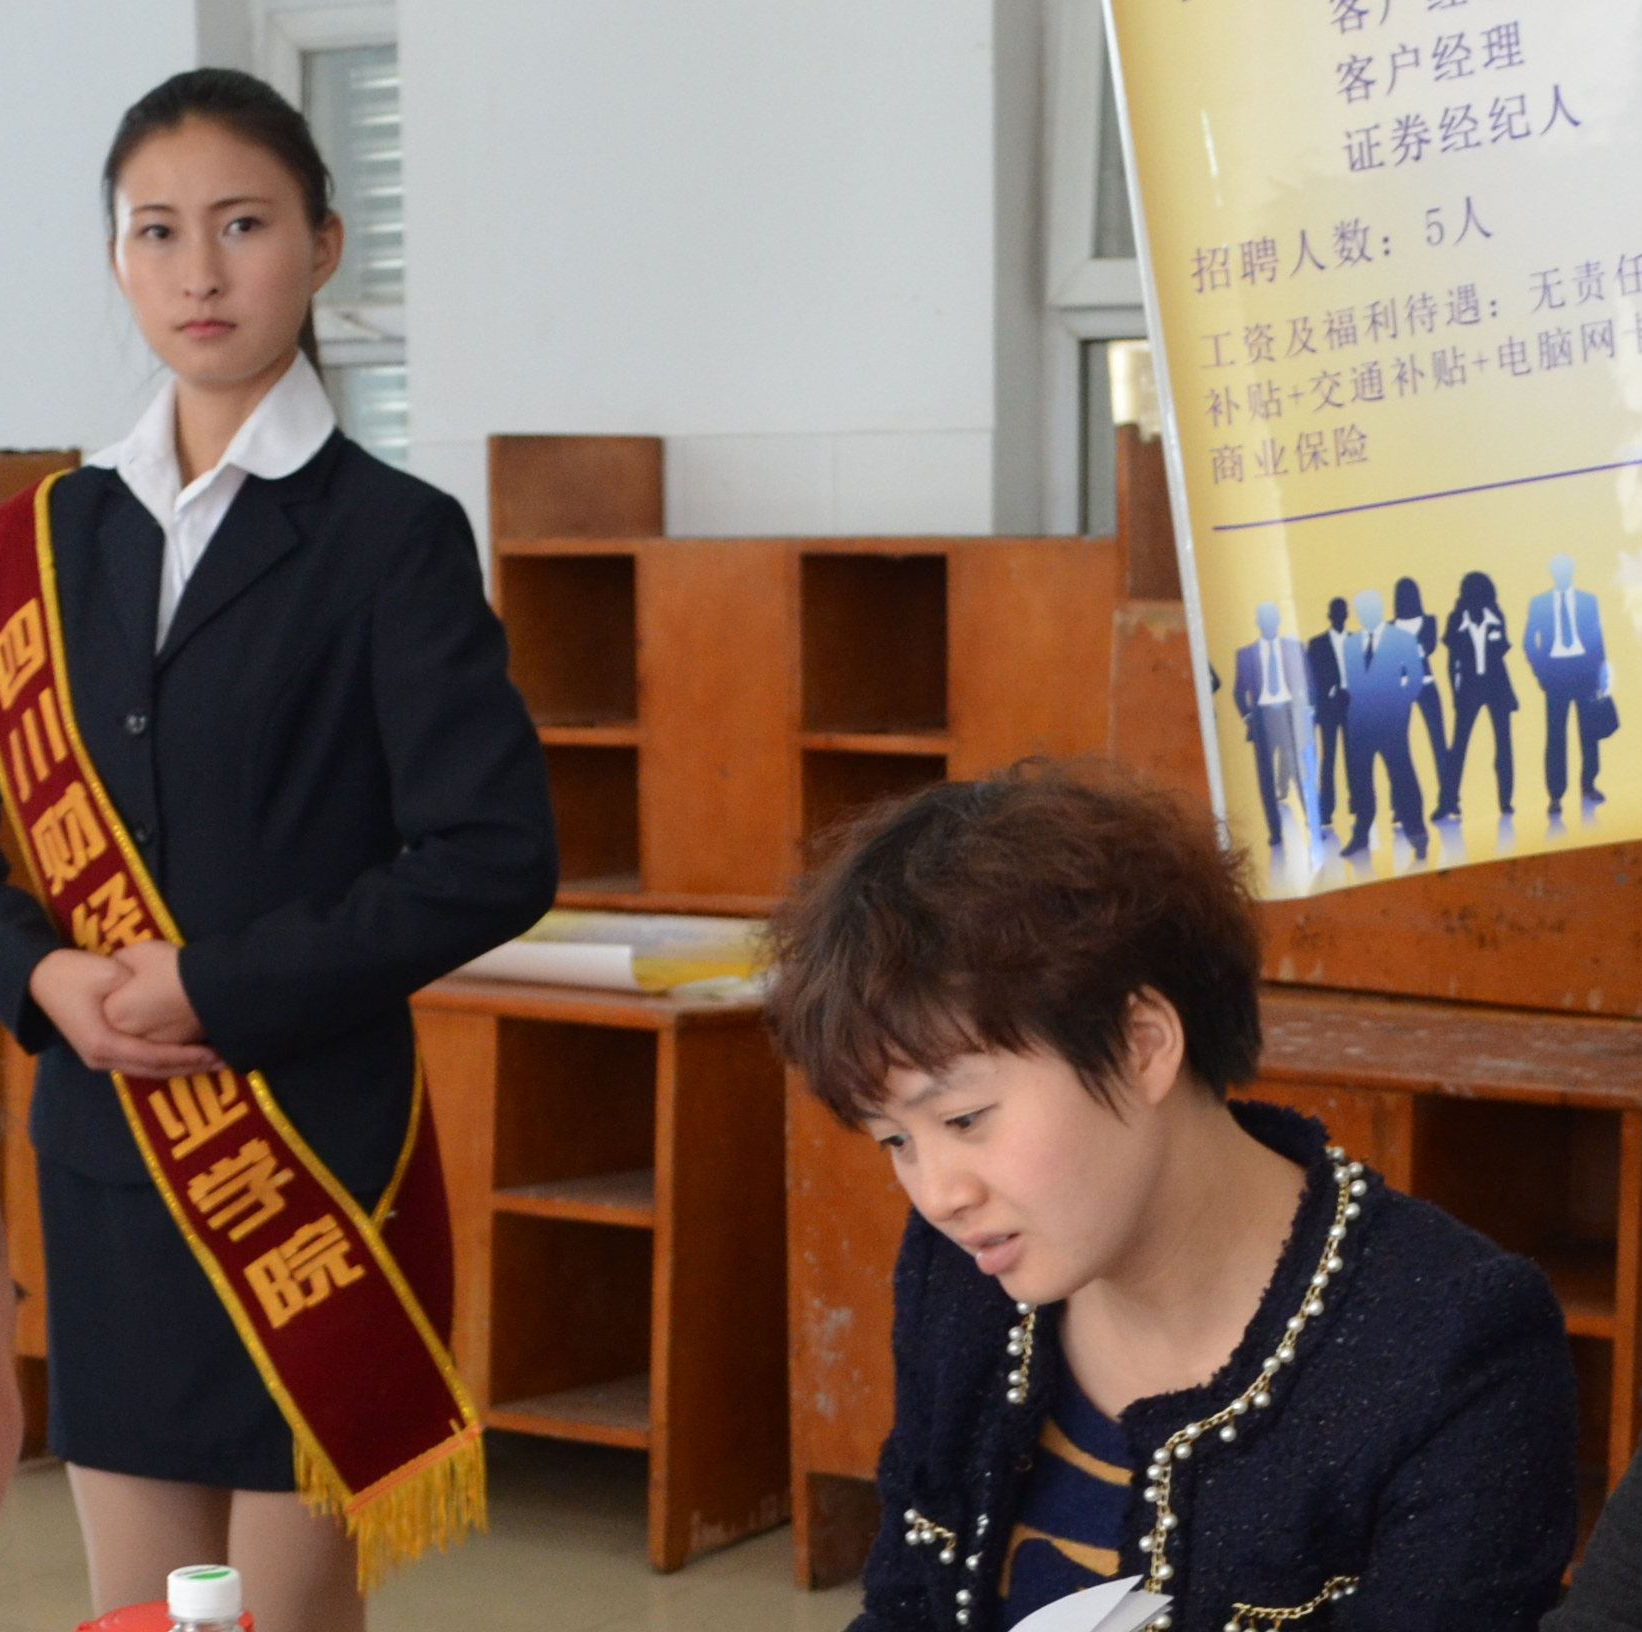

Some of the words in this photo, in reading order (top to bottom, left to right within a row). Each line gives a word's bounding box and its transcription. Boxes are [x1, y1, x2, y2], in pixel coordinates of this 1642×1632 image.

[1336, 21, 1525, 103] 客户经理
[1344, 84, 1581, 172] 证券经纪人
[1209, 423, 1369, 485] 商业保险
